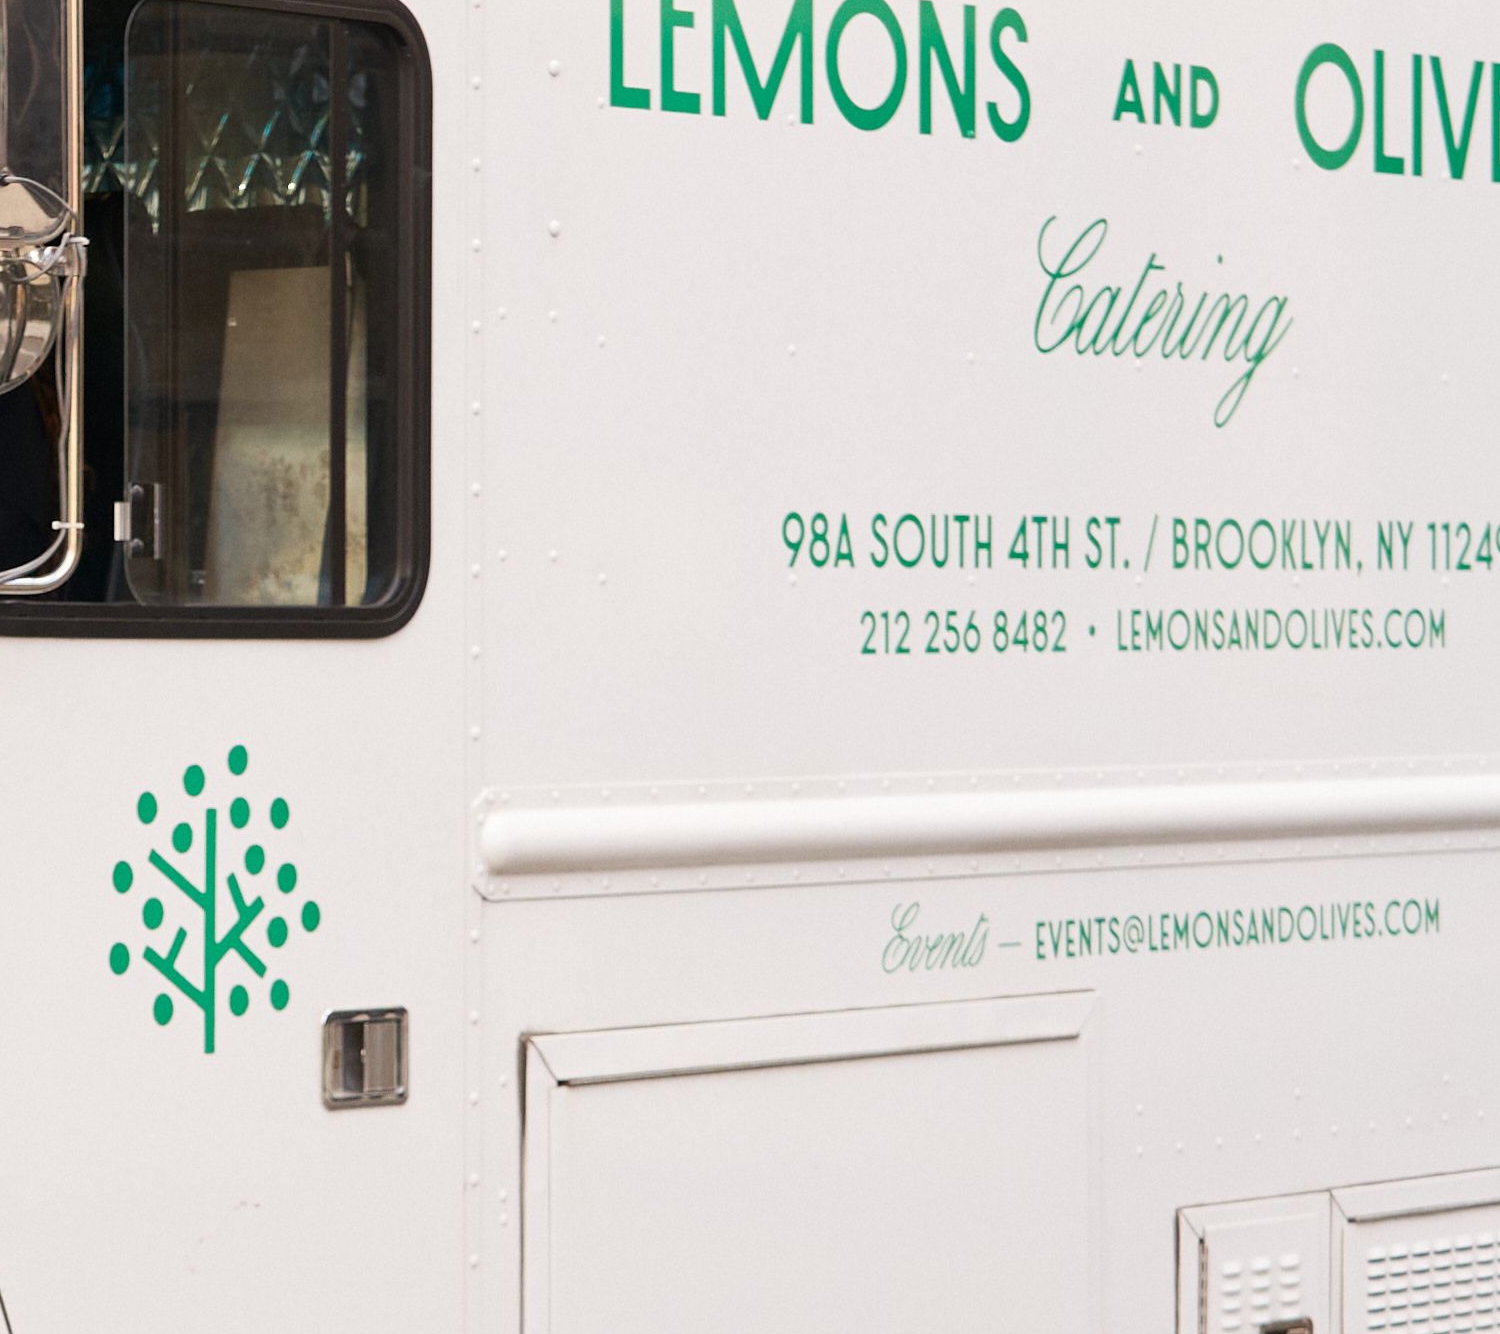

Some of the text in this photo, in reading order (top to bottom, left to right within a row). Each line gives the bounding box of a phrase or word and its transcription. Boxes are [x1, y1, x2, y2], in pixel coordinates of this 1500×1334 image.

[1111, 58, 1221, 131] AND
[1032, 214, 1293, 429] Catering
[782, 511, 856, 570] 98A
[870, 512, 994, 570] SOUTH
[1007, 515, 1071, 570] 4TH
[1084, 516, 1130, 571] ST.
[1171, 518, 1363, 576] BROOKLYN,
[1376, 522, 1415, 571] NY
[859, 609, 912, 656] 212
[923, 609, 982, 656] 256
[992, 609, 1067, 654] 8482
[1116, 608, 1447, 653] LEMONSANDOLIVES.COM
[881, 900, 990, 975] Events
[1034, 897, 1441, 962] EVENTS@LEMONSANDOLIVES.COM
